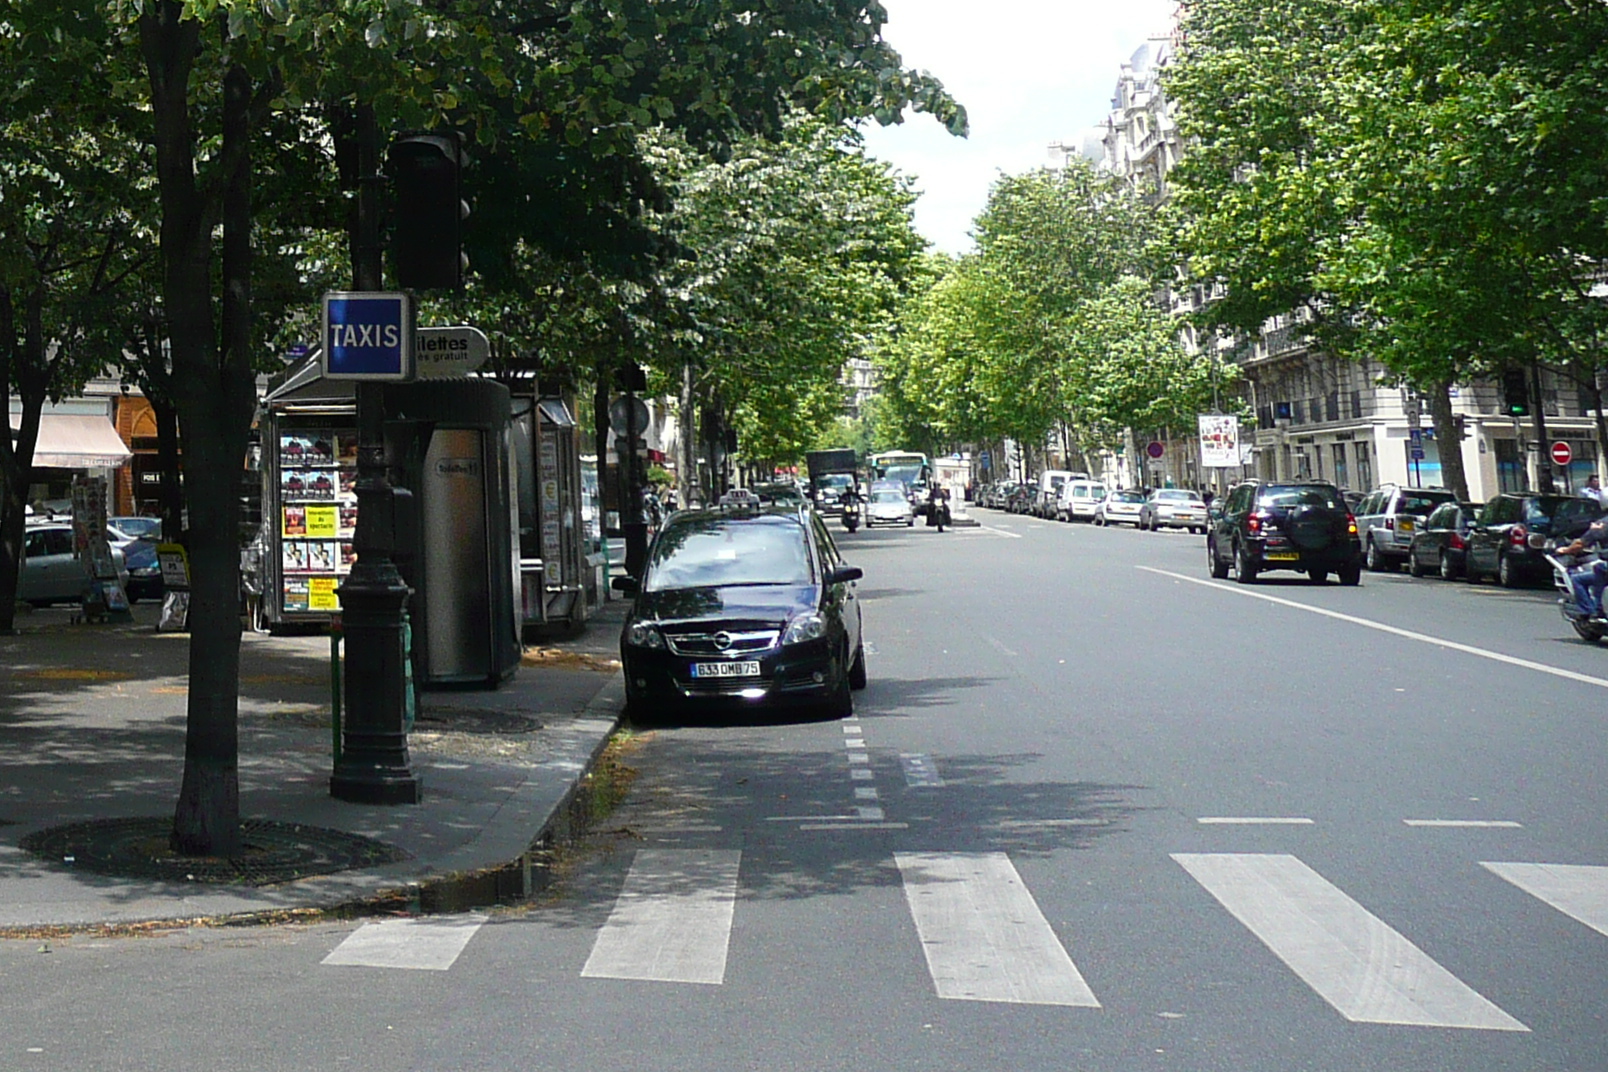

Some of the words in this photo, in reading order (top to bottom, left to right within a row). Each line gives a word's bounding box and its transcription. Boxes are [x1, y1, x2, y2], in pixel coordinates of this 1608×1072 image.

[330, 324, 399, 348] TAXIS
[417, 336, 468, 351] ilettes
[698, 663, 720, 676] 633
[743, 662, 759, 674] 75
